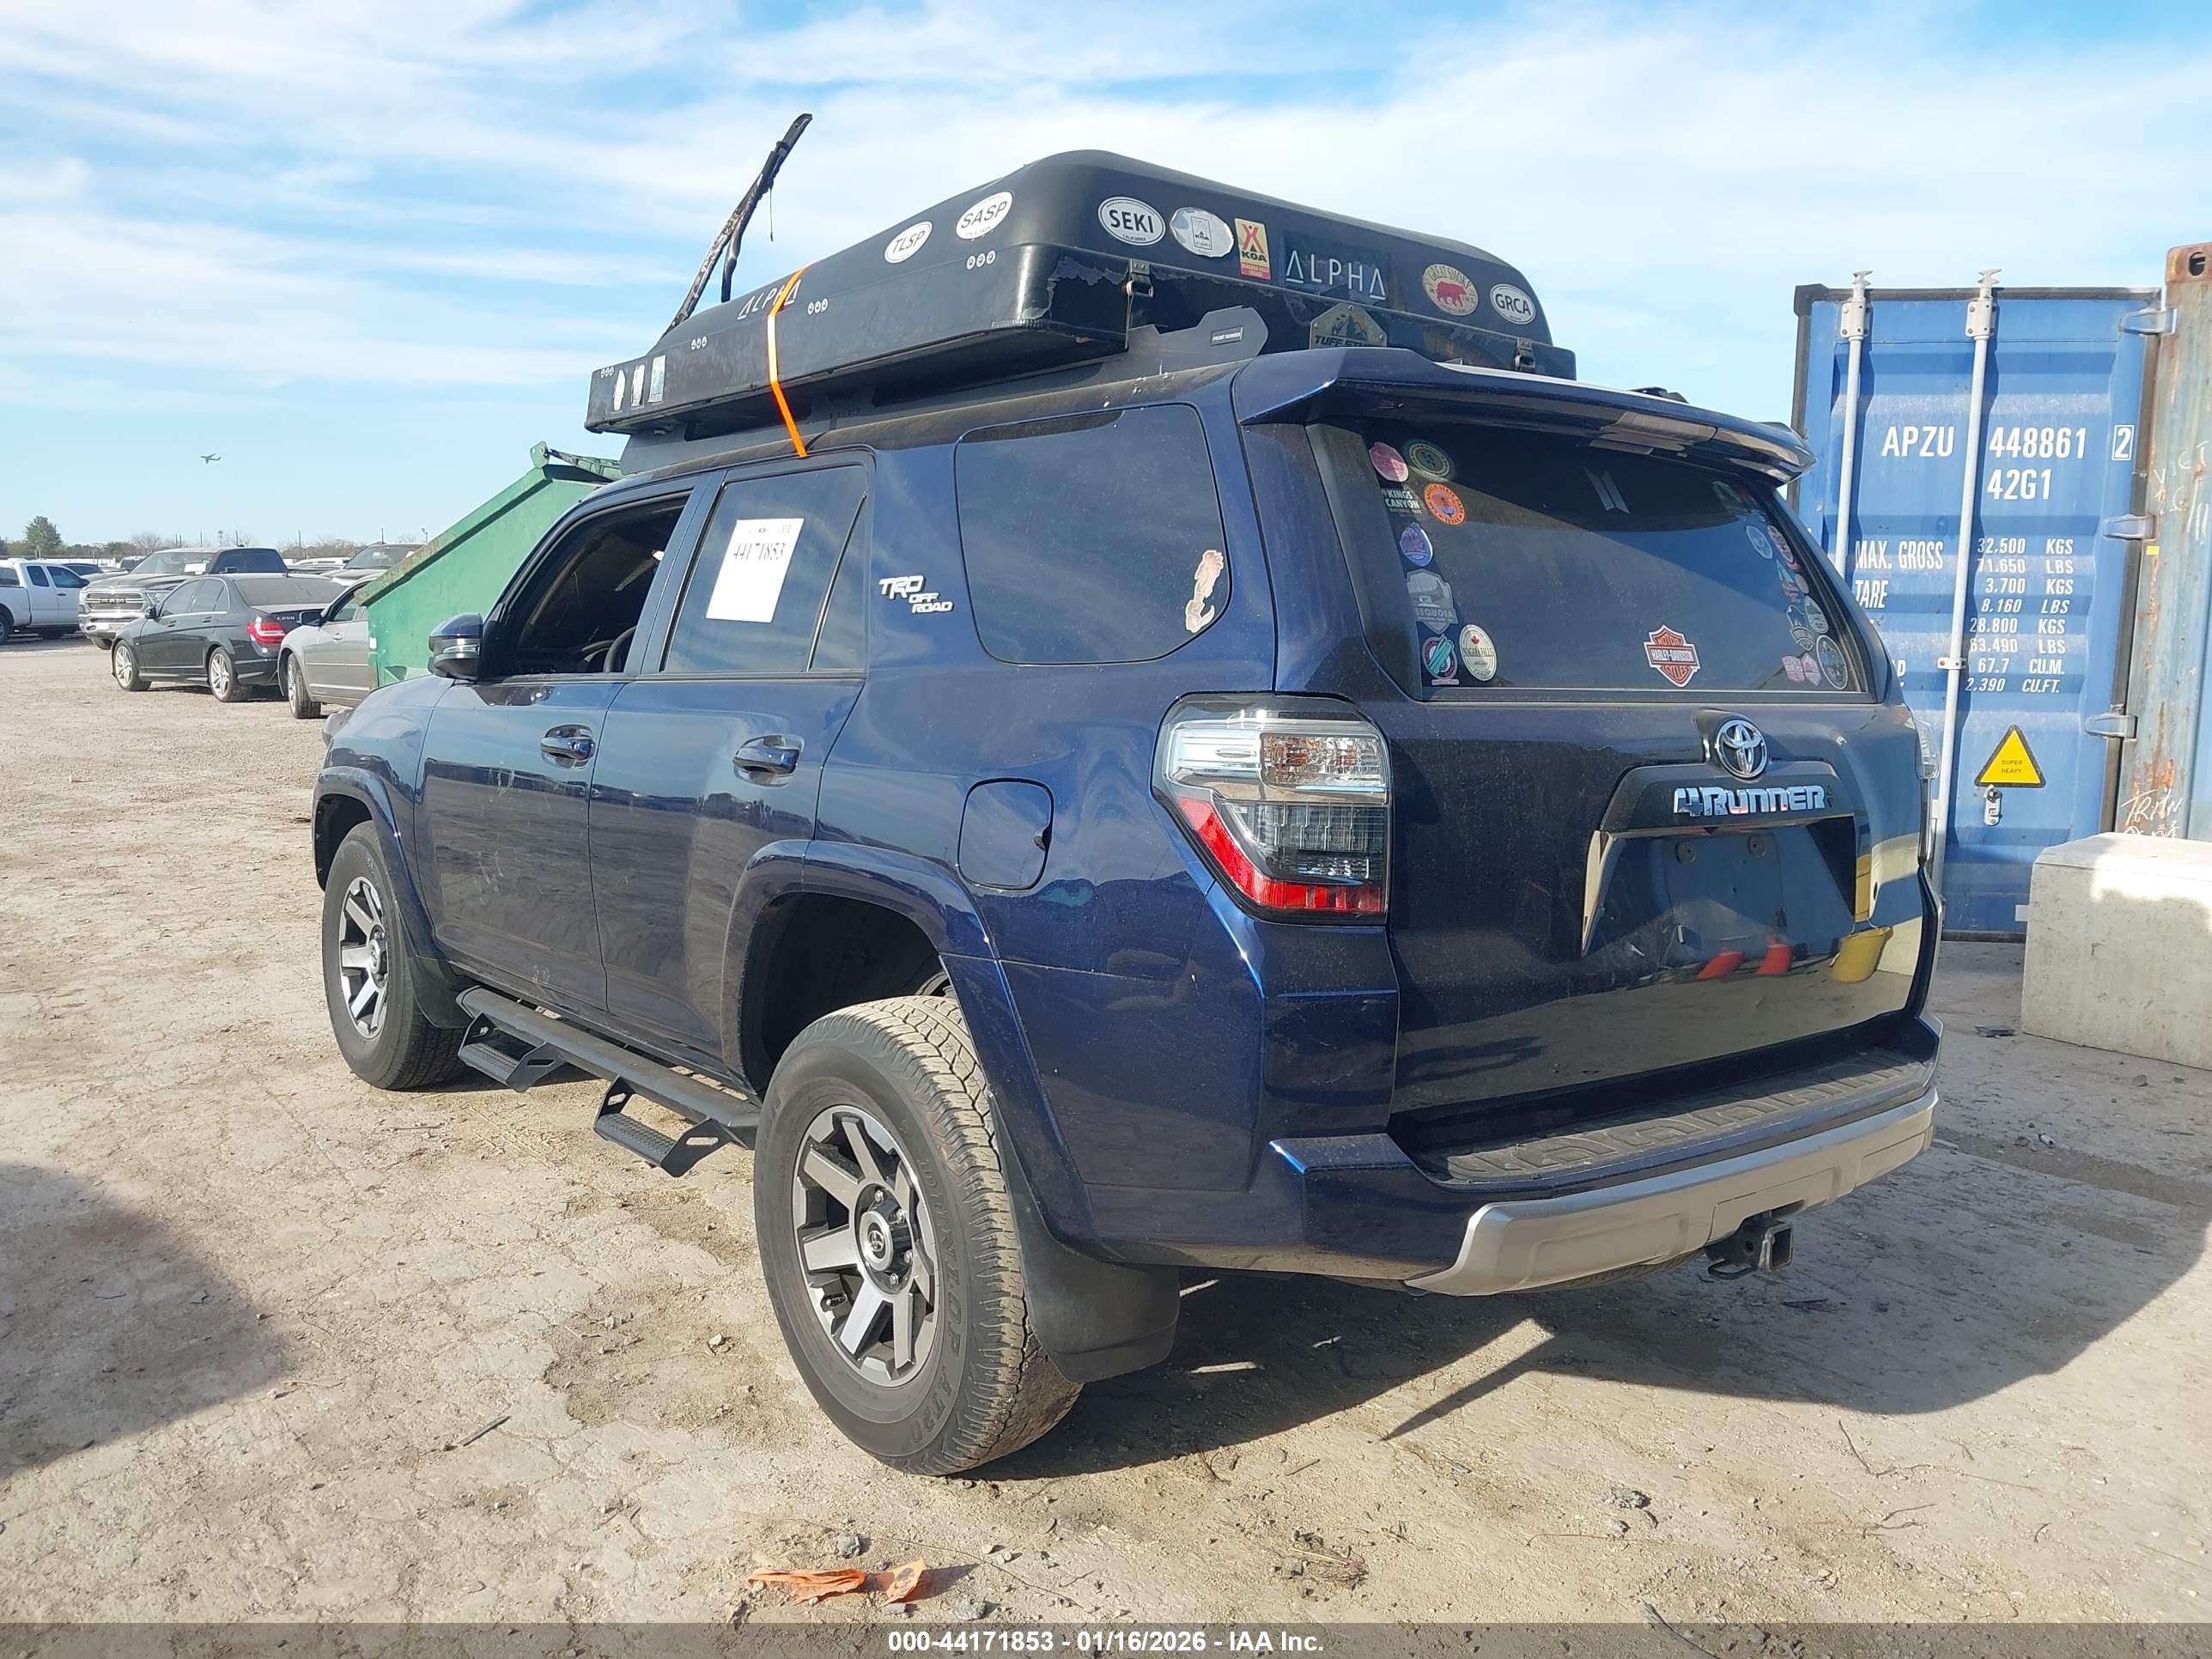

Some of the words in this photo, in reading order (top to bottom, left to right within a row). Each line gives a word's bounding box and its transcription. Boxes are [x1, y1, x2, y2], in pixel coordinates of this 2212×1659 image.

[960, 200, 1008, 229] SASP
[1109, 209, 1154, 234] SEKI
[891, 229, 927, 254] TLSP
[1241, 251, 1268, 263] KOA
[1285, 250, 1387, 301] ALPHA
[1495, 293, 1532, 317] GRCA
[1881, 426, 1955, 458] APZU
[1988, 426, 2087, 459] 448861
[2114, 428, 2131, 459] 2
[1987, 468, 2052, 501] 42G1
[1387, 489, 1413, 500] KINGS
[1385, 498, 1420, 510] CANYON
[1855, 540, 1893, 569] MAX.
[1899, 540, 1944, 570] GROSS
[2045, 538, 2075, 555] KGS
[2045, 559, 2075, 574] LBS
[878, 574, 926, 600] TRD
[1855, 580, 1890, 609] TARE
[2045, 578, 2075, 595] KGS
[908, 592, 940, 605] OFF
[911, 600, 954, 614] ROAD
[2040, 599, 2071, 614] LBS
[1415, 607, 1454, 618] SEQUOIA
[2038, 618, 2066, 635] KGS
[1656, 634, 1681, 646] MOTOR
[2039, 638, 2067, 654] LBS
[1978, 658, 2010, 674] 67.7
[2029, 659, 2065, 675] CU.M.
[2021, 678, 2061, 693] CU.FT.
[1674, 785, 1826, 817] 4RUNNER
